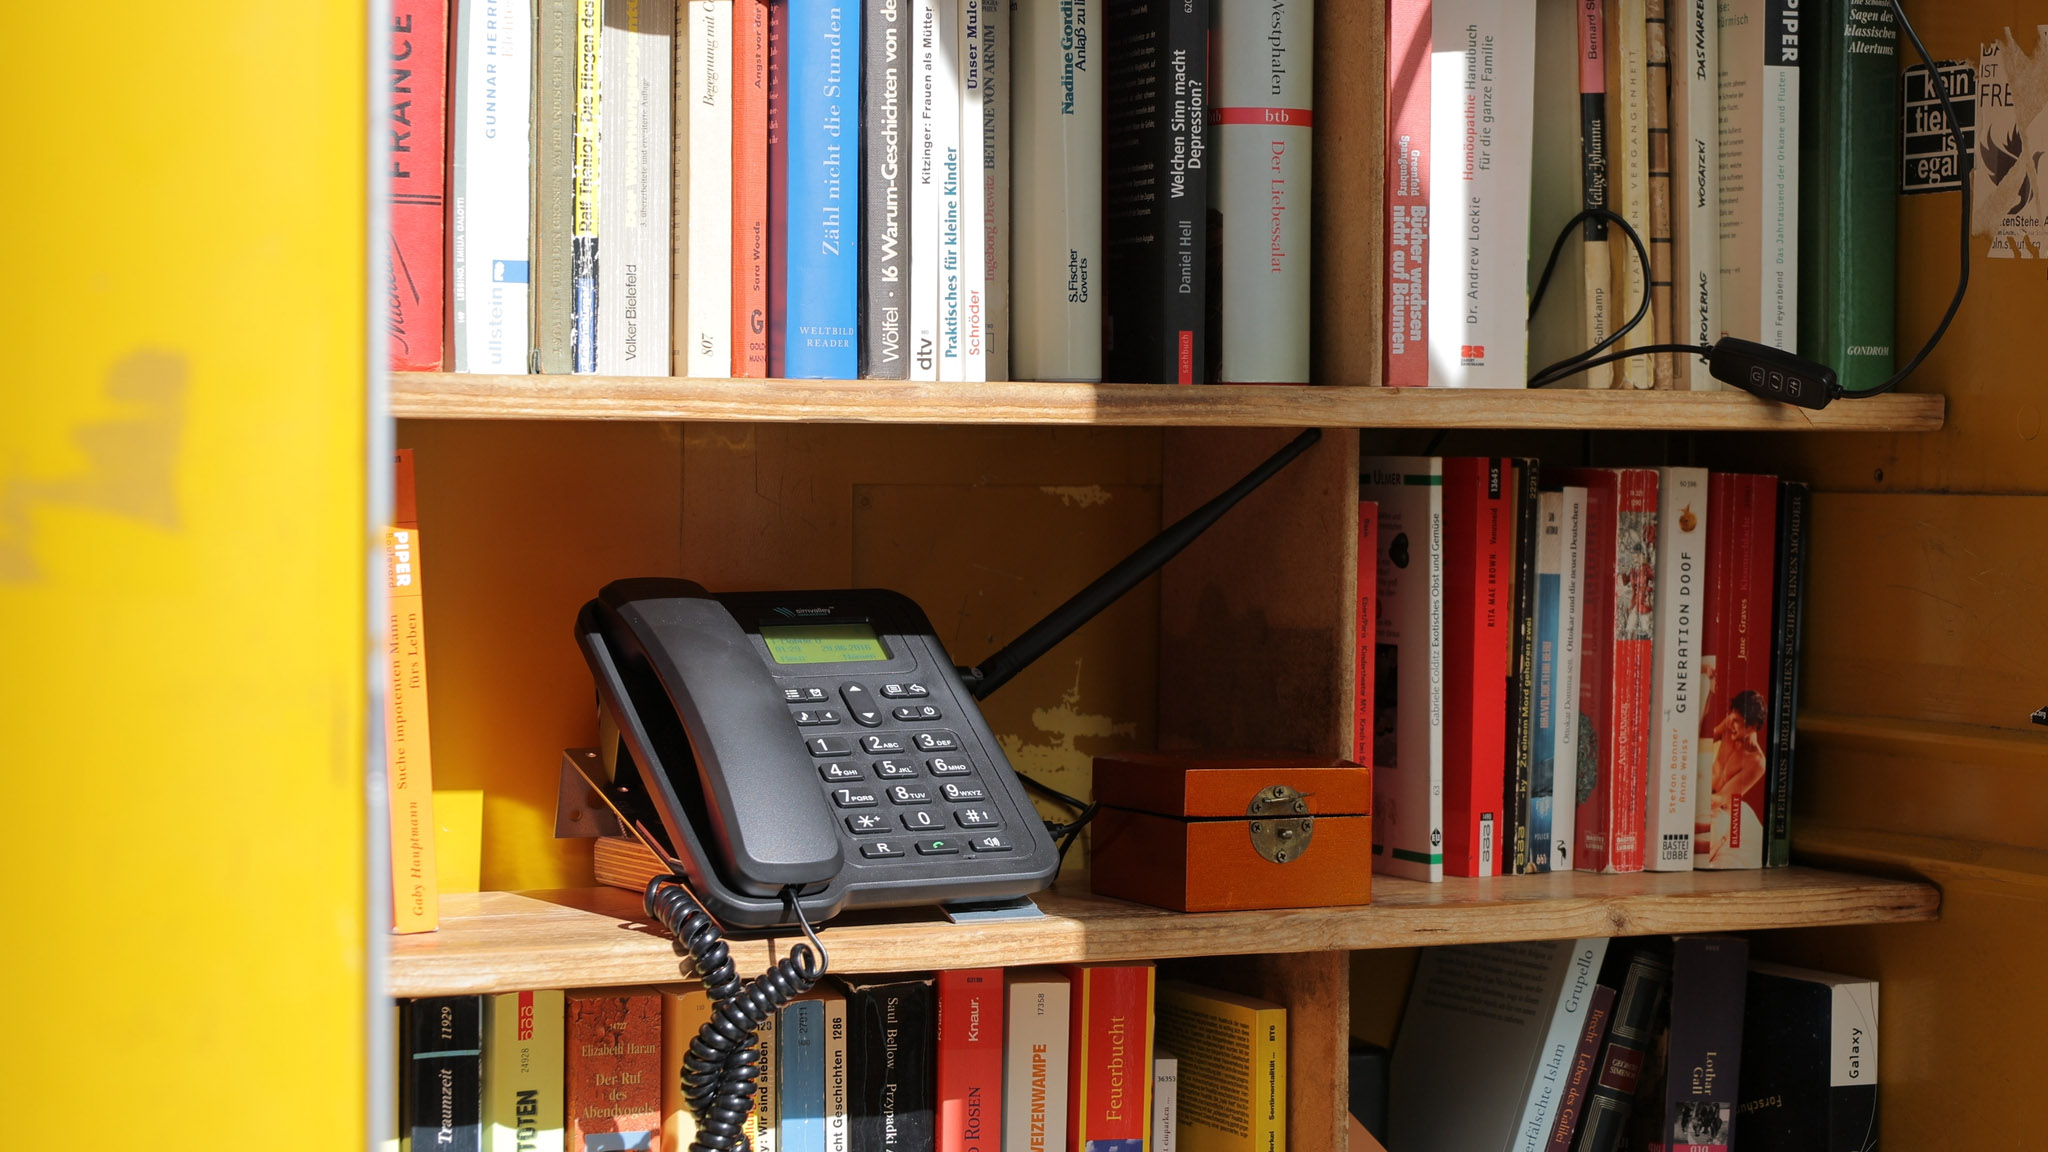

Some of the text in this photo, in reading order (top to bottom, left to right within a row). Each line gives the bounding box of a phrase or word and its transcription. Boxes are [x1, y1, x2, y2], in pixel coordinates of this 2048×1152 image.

[1077, 8, 1086, 25] zu
[1586, 14, 1598, 60] Bernard
[1844, 24, 1897, 40] klassischen
[1849, 8, 1893, 25] Sagen des
[702, 39, 719, 107] Begegnung
[966, 43, 978, 89] Unser
[983, 24, 995, 75] ARNIM
[1848, 41, 1894, 56] Altertums
[1980, 64, 1998, 78] IST
[485, 64, 497, 139] GUNNAR
[921, 6, 933, 185] Kitzinger: Frauen als Mütter
[983, 77, 995, 105] VON
[1061, 52, 1074, 115] Nadine
[1463, 24, 1478, 181] Homöopathie Handbuch
[1478, 35, 1495, 170] für die ganze Familie
[821, 7, 841, 256] Zähl nicht die Stunden
[983, 108, 995, 170] BETTINE
[1170, 49, 1186, 198] Welchen Sinn macht
[1187, 79, 1205, 169] Depression?
[1265, 109, 1289, 122] btb
[1775, 71, 1786, 265] Das Jahrtausend Orkane und Fluten
[1917, 155, 1958, 185] egal
[880, 28, 899, 363] Wölfel Warum-Geschichten von
[984, 175, 995, 224] Drewitz
[1271, 140, 1287, 274] Der Liebessalat
[753, 221, 761, 261] Woods
[944, 146, 957, 358] Praktisches für kleine Kinder
[984, 226, 998, 281] Ingeborg
[1179, 220, 1192, 294] Daniel Hell
[1466, 196, 1480, 324] Dr. Andrew Lockie
[1079, 257, 1088, 303] Goverts
[1392, 205, 1411, 355] nicht auf Bäumen
[1410, 205, 1429, 342] Bücher wachsen
[625, 264, 637, 361] Volker Bielefeld
[968, 290, 980, 356] Schröder
[1774, 271, 1786, 327] Feyerabend
[488, 287, 503, 365] ullstein
[701, 332, 714, 357] 807
[799, 326, 854, 336] WELTBILD
[807, 339, 849, 348] READER
[1847, 345, 1890, 356] GONDROM
[916, 337, 932, 371] dtv
[1181, 334, 1190, 374] sachbuch
[1490, 468, 1498, 493] 13645
[393, 531, 412, 586] PIPER
[1566, 502, 1580, 652] Ottokar und Deutschen
[405, 612, 418, 657] Leben
[1430, 513, 1441, 727] Gabriele Colditz Exotisches Obst und Gemüse
[1676, 551, 1691, 713] GENERATION DOOF
[1737, 598, 1748, 661] Jane Graves
[1521, 617, 1533, 751] einem Mord zwei
[1777, 556, 1798, 819] FERRARS DREI LEICHEN SUCHEN EINEN
[392, 660, 407, 790] Suche impotenten
[816, 738, 828, 751] 1
[869, 736, 883, 749] 2
[920, 733, 935, 747] 3
[830, 763, 842, 777] 4
[882, 760, 896, 774] 5
[934, 758, 948, 772] 6
[946, 783, 959, 797] 9
[1668, 728, 1678, 814] Stefan Bonner
[1679, 738, 1688, 803] Anne Weiss
[838, 789, 850, 803] 7
[895, 786, 909, 800] 8
[917, 811, 931, 825] 0
[1731, 796, 1740, 845] BLANVALET
[409, 801, 425, 916] Gaby Hauptmann
[876, 843, 891, 853] R
[1037, 993, 1045, 1017] 17358
[1565, 950, 1594, 1014] Grupello
[441, 1006, 453, 1040] 11929
[886, 997, 899, 1069] Saul Bellow
[1586, 1009, 1604, 1044] Brecht
[582, 1043, 656, 1057] Elizabeth Haran
[832, 1017, 843, 1129] Geschichten 1286
[1106, 1015, 1125, 1122] Feuerbucht
[1545, 1044, 1565, 1082] Islam
[1704, 1051, 1718, 1096] Lothar
[1849, 1028, 1862, 1079] Galaxy
[595, 1070, 642, 1086] Der Ruf
[609, 1088, 628, 1101] des
[757, 1041, 768, 1137] Wir sind sieben
[1555, 1053, 1591, 1144] Leben des Galilei
[1692, 1066, 1704, 1095] Gall
[437, 1069, 453, 1145] Traumzeit
[582, 1102, 655, 1119] Abendvogels
